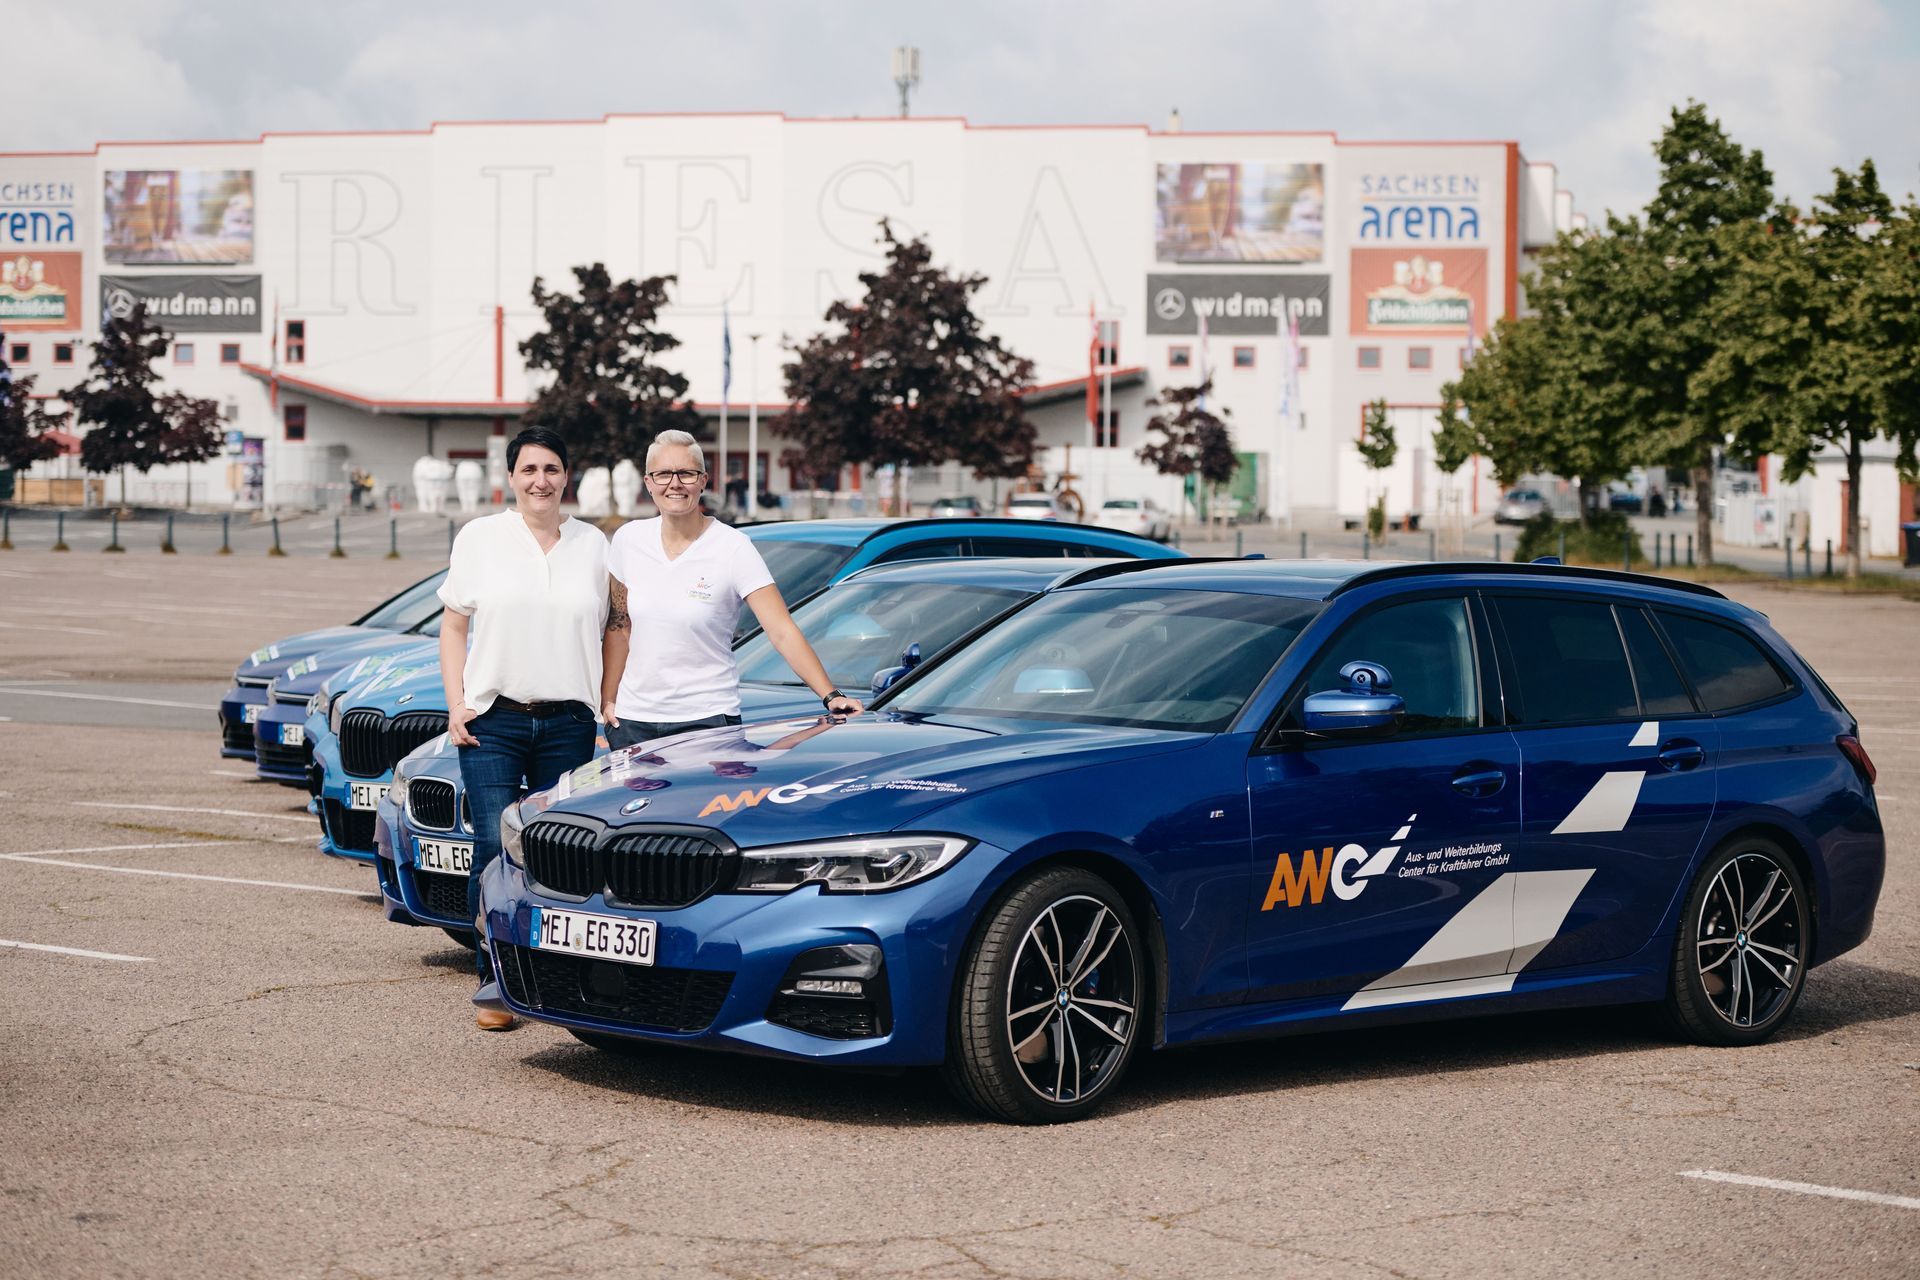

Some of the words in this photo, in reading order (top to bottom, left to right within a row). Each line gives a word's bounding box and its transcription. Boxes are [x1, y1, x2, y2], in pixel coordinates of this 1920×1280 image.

[1361, 175, 1479, 194] SACHSEN
[1360, 205, 1479, 238] arena
[141, 291, 256, 316] widmann
[1191, 291, 1323, 318] widmann
[351, 786, 371, 807] MEI
[697, 783, 809, 818] AWC
[420, 842, 443, 869] MEI
[1398, 865, 1425, 878] Center
[1426, 862, 1440, 874] für
[1439, 858, 1483, 873] Kraftfahrer
[1484, 853, 1510, 867] GmbH
[1404, 851, 1425, 864] Aus-
[1426, 848, 1443, 860] und
[1444, 842, 1502, 859] Weiterbildungs
[1261, 843, 1370, 912] AWC
[540, 913, 571, 947] MEI
[586, 920, 609, 952] EG
[614, 923, 650, 958] 330
